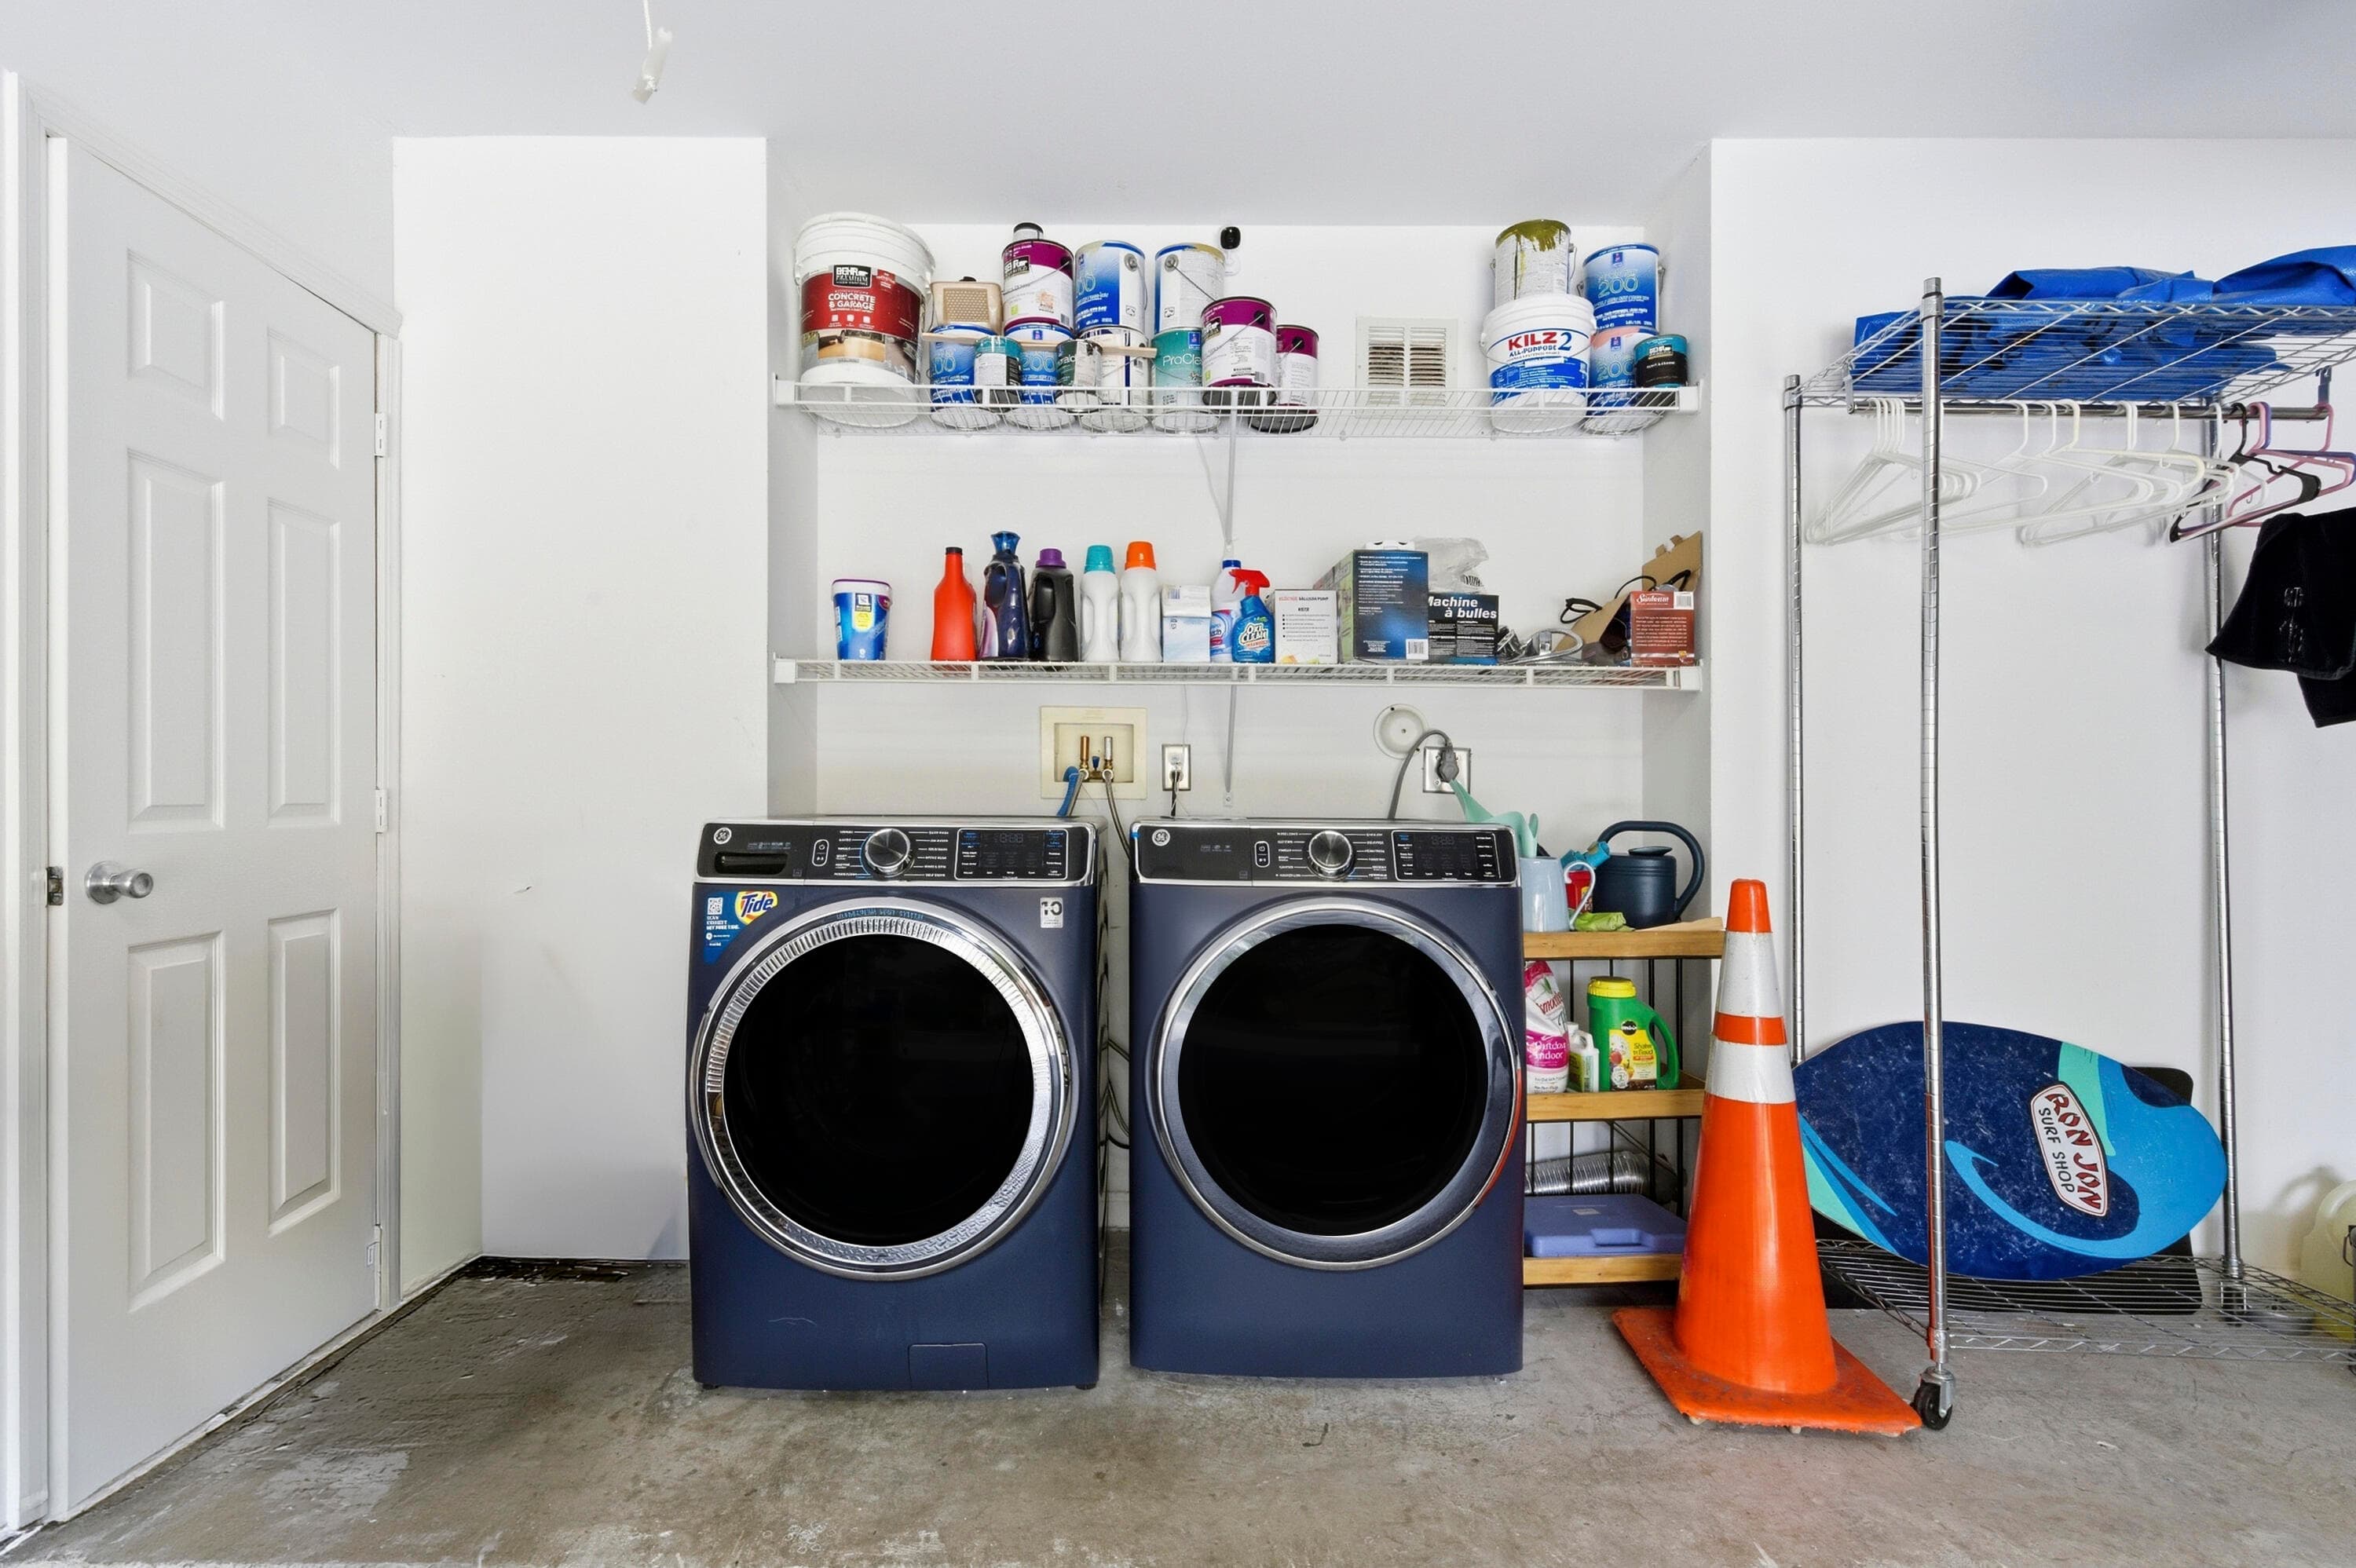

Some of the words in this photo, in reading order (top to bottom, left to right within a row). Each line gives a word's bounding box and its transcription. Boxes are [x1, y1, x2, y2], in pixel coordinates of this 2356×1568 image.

[836, 267, 858, 276] BEHR
[1598, 275, 1638, 298] 200
[828, 292, 876, 303] CONCRETE
[837, 301, 875, 311] GARAGE
[1508, 331, 1557, 351] KILZ
[1558, 331, 1572, 351] 2
[1444, 607, 1453, 618] à
[1457, 608, 1497, 619] bulles
[741, 893, 774, 917] Tide
[2038, 1107, 2062, 1144] SURF
[2052, 1151, 2075, 1193] SHOP
[2044, 1094, 2093, 1146] RON
[2073, 1153, 2102, 1210] JON
